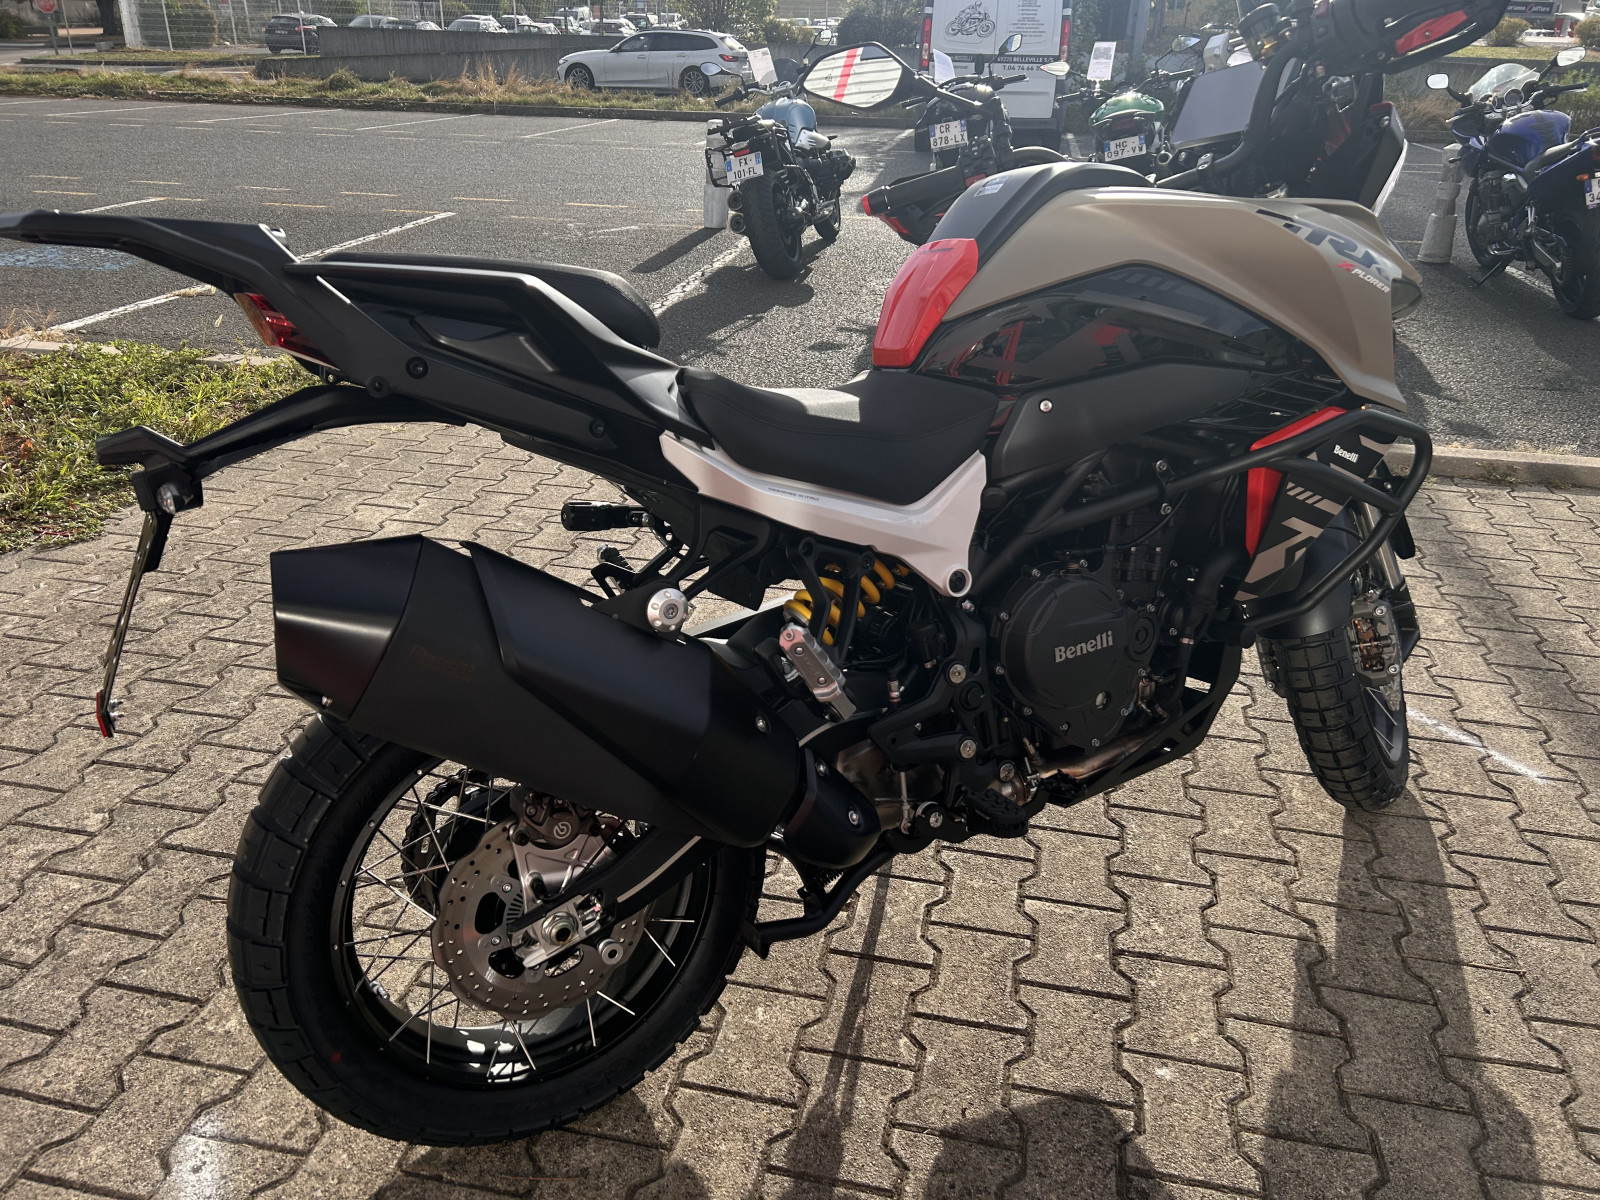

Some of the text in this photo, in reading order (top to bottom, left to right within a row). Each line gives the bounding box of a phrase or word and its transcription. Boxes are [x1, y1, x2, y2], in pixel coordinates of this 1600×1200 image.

[932, 132, 966, 147] 878-LX
[733, 166, 758, 180] 101-FL
[1333, 444, 1359, 463] Benelli
[1054, 630, 1113, 663] Benelli
